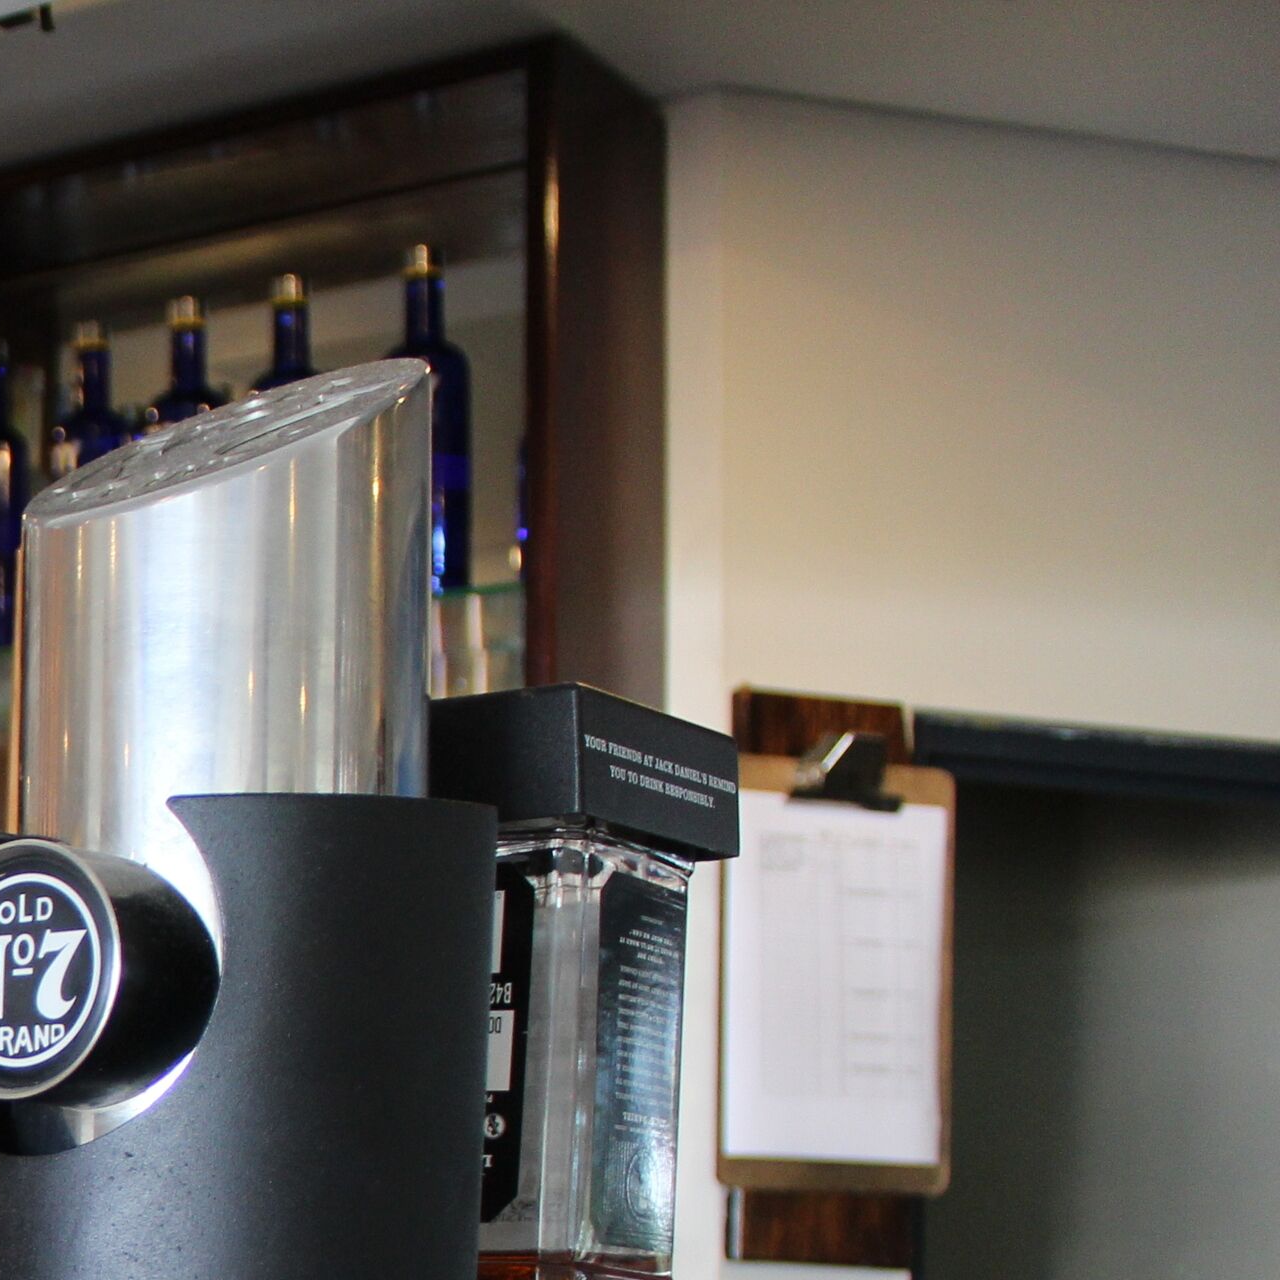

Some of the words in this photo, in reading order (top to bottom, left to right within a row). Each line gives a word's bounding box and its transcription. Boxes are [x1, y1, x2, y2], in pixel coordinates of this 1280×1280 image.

[584, 734, 607, 752] YOUR
[608, 742, 642, 764] FRIENDS
[643, 754, 655, 767] AT
[654, 757, 674, 775] JACK
[675, 763, 708, 786] DANIEL'S
[708, 774, 737, 794] REMIND
[610, 765, 628, 780] YOU
[628, 771, 639, 784] TO
[640, 774, 664, 792] DRINK
[665, 783, 716, 809] RESPONSIBLY.
